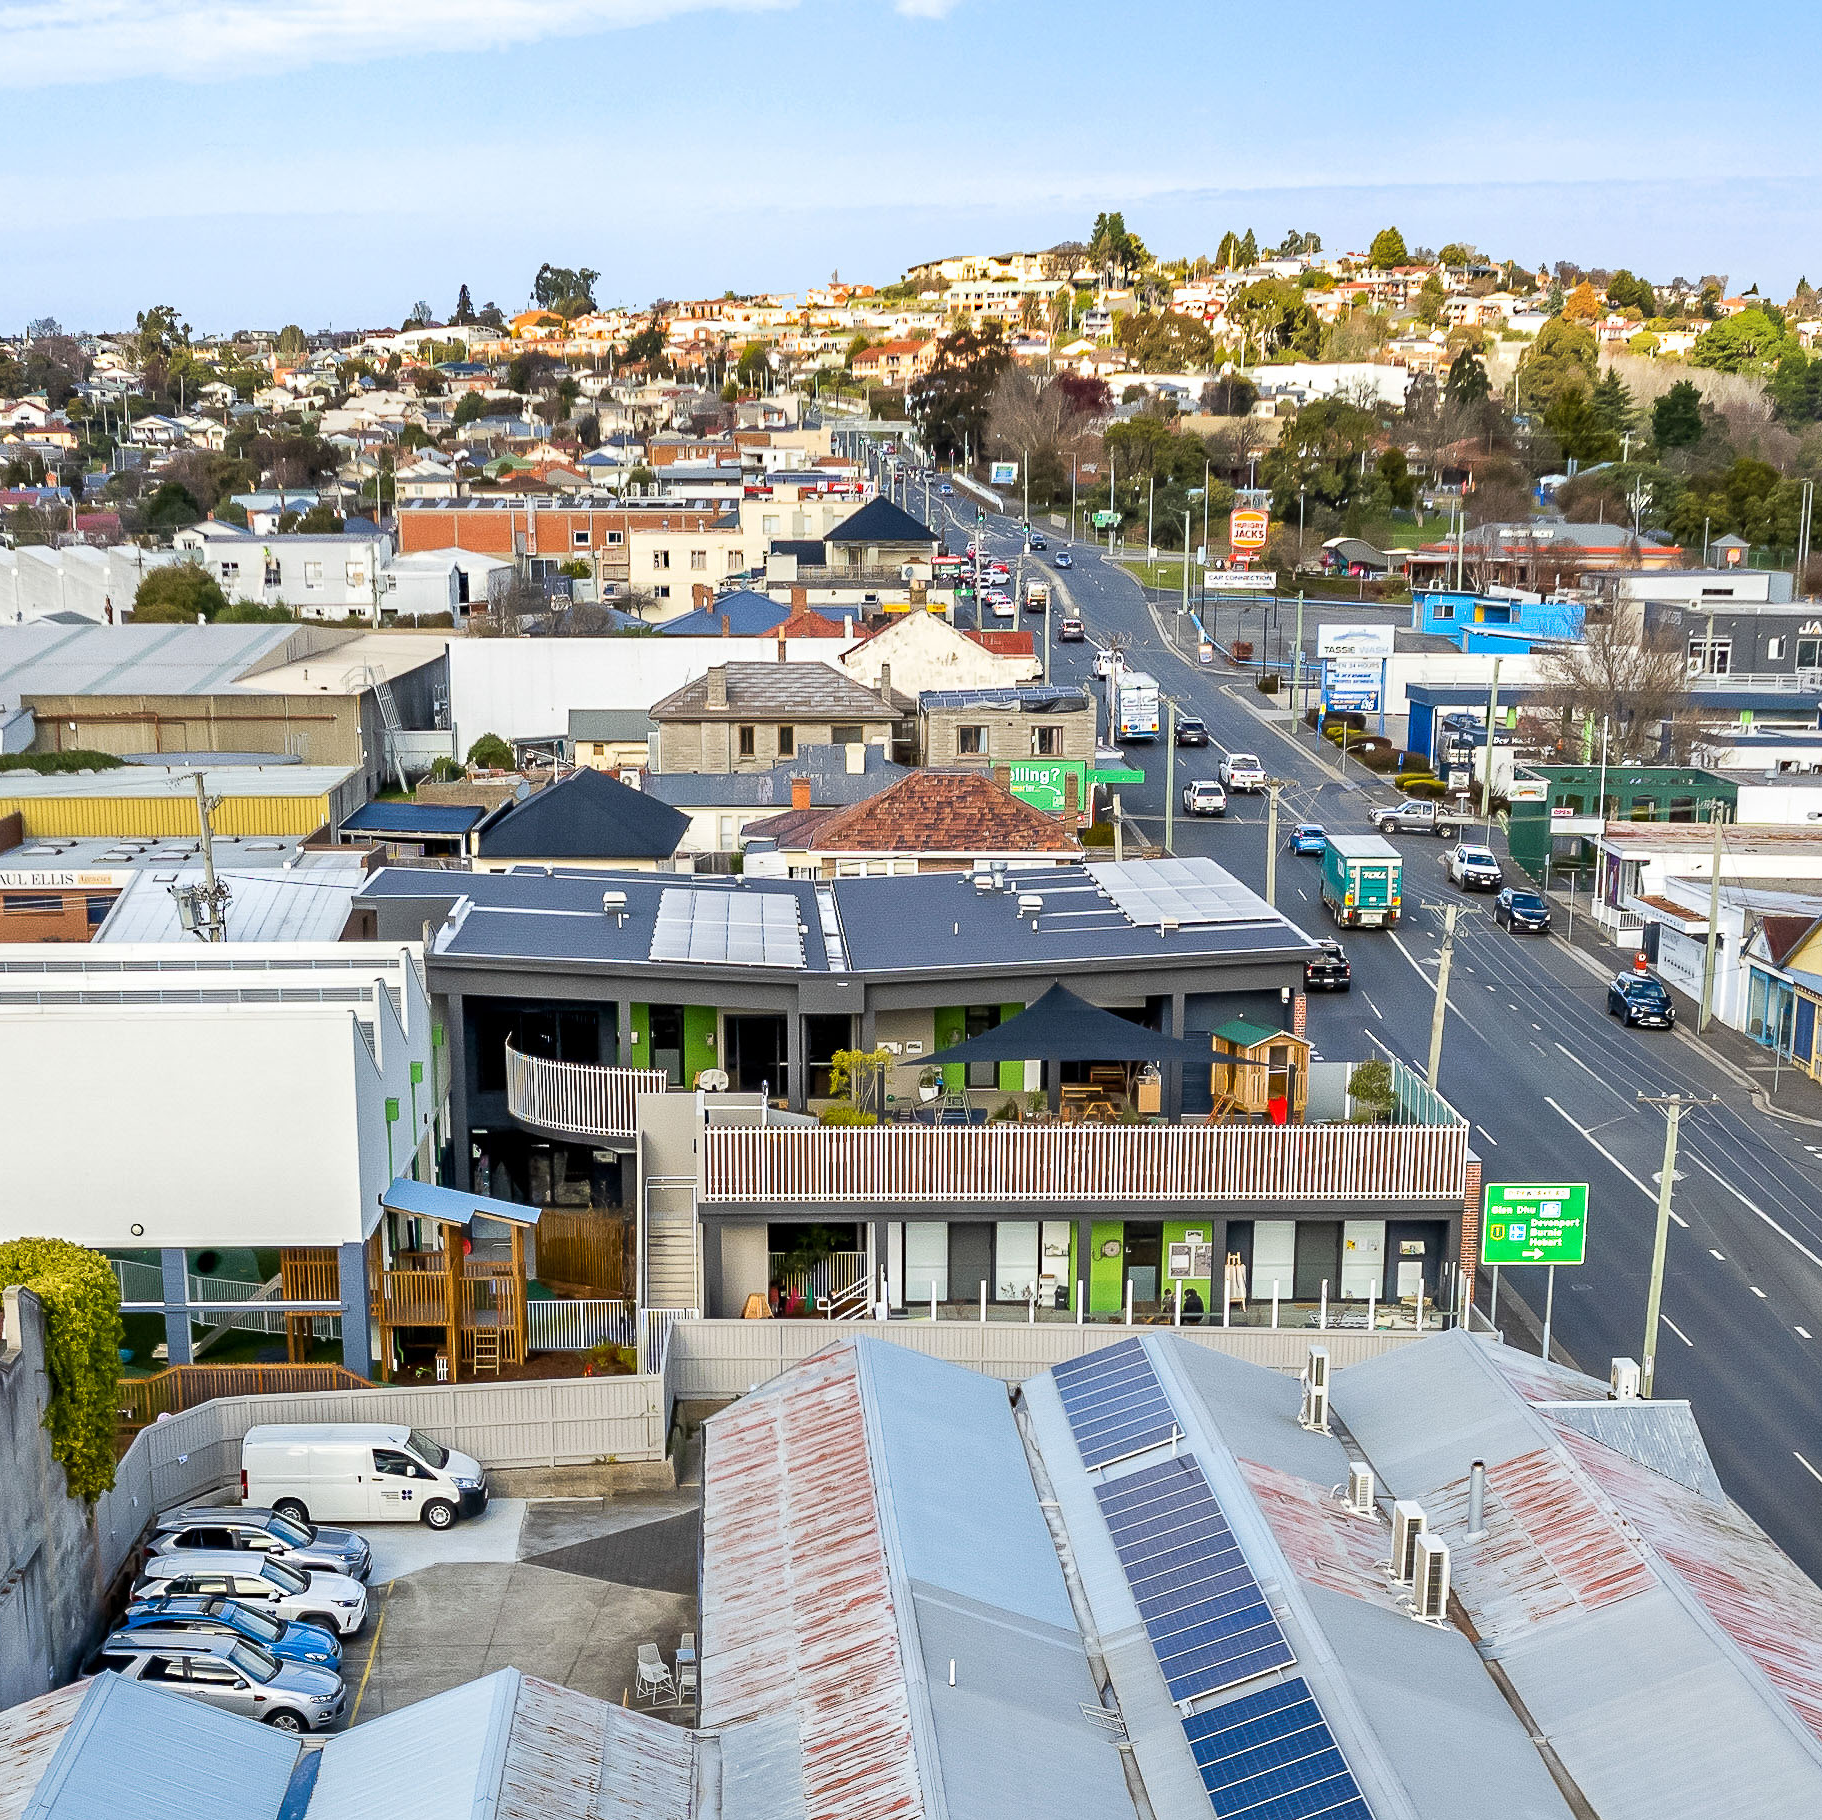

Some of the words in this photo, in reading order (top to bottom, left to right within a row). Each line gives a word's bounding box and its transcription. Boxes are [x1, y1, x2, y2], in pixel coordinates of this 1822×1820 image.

[1324, 646, 1356, 654] TASSIE
[1359, 646, 1389, 654] WASH
[31, 873, 75, 886] ELLIS
[1362, 871, 1387, 880] TOLL
[1516, 1204, 1537, 1215] Dhu
[1530, 1217, 1581, 1229] Devonport
